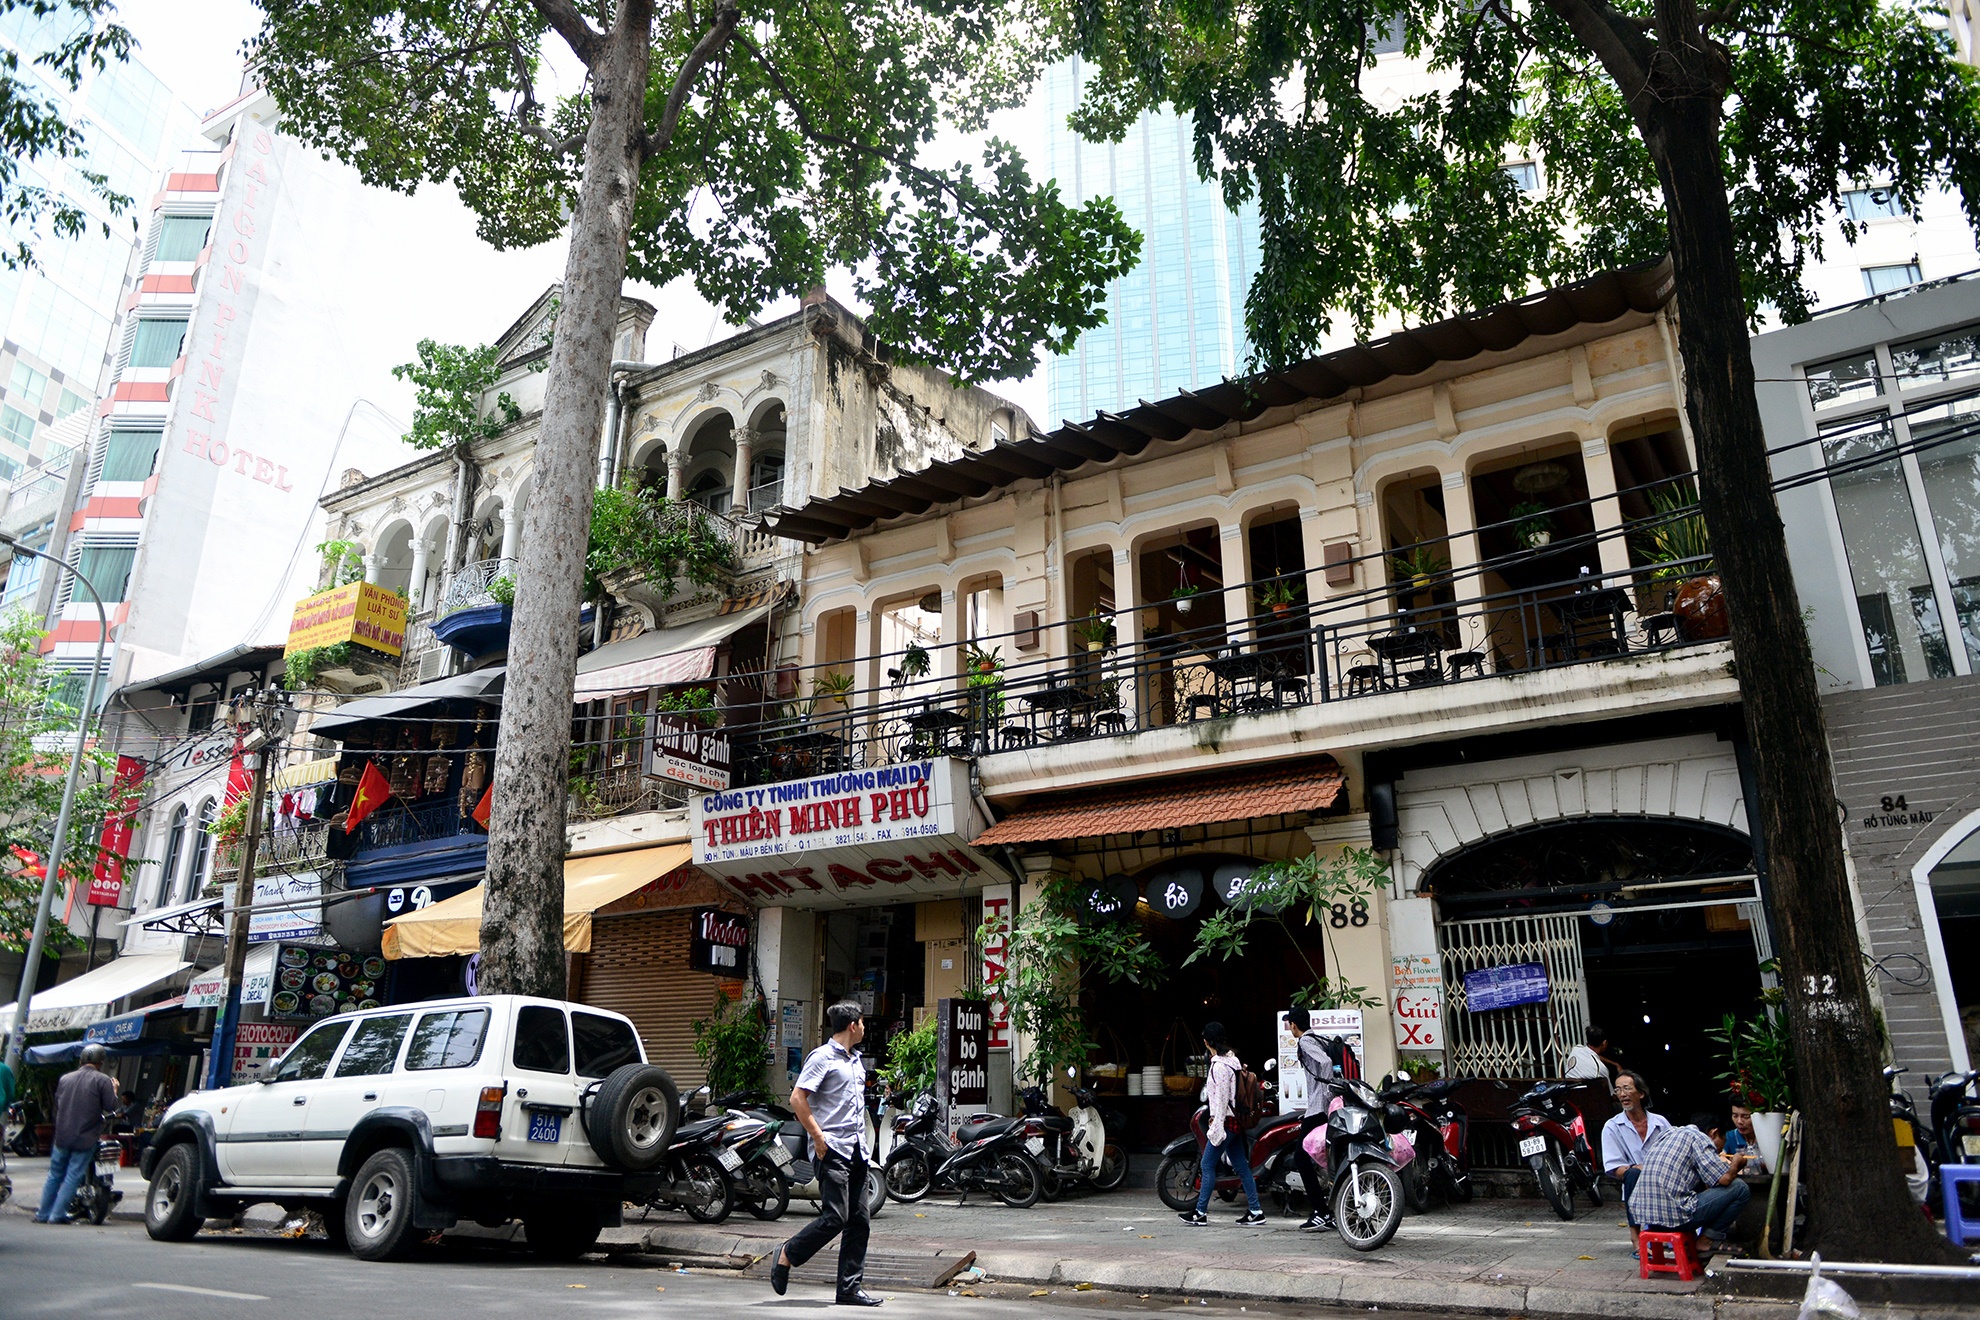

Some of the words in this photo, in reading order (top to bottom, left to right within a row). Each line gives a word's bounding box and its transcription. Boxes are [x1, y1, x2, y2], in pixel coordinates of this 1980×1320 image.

[220, 130, 272, 295] SAIGON
[190, 302, 237, 424] PINK
[183, 428, 294, 494] HOTEL
[364, 587, 378, 600] VĂN
[380, 594, 405, 610] PHÒNG
[367, 602, 387, 617] LUẬT
[656, 715, 680, 750] bún
[682, 722, 698, 755] bò
[700, 731, 730, 764] gánh
[666, 768, 694, 782] đặc
[700, 776, 726, 790] biệt
[668, 758, 686, 768] các
[689, 763, 706, 774] loại
[708, 769, 726, 778] chè
[704, 791, 744, 813] CÔNG
[745, 790, 766, 807] TY
[768, 782, 808, 804] TNHH
[810, 771, 875, 797] THƯƠNG
[1881, 795, 1908, 812] 84
[703, 805, 782, 847] THIÊN
[788, 796, 862, 835] MINH
[870, 778, 929, 824] PHÚ
[1880, 814, 1908, 827] TÙNG
[1910, 811, 1933, 824] MẬU
[704, 853, 712, 862] 90
[740, 846, 753, 858] MẬU
[877, 830, 892, 840] FAX
[1163, 882, 1188, 910] bò
[1330, 902, 1370, 929] 88
[701, 912, 748, 946] Voodoo
[190, 982, 221, 996] PHOTOCOPY
[246, 988, 262, 1001] DECAL
[957, 1006, 982, 1030] bún
[236, 1025, 296, 1043] PHOTOCOPY
[1400, 1023, 1434, 1045] Xe
[234, 1046, 252, 1058] IN
[960, 1035, 977, 1060] bò
[951, 1064, 984, 1094] gánh
[536, 1114, 555, 1128] 51A
[530, 1126, 557, 1142] 2400
